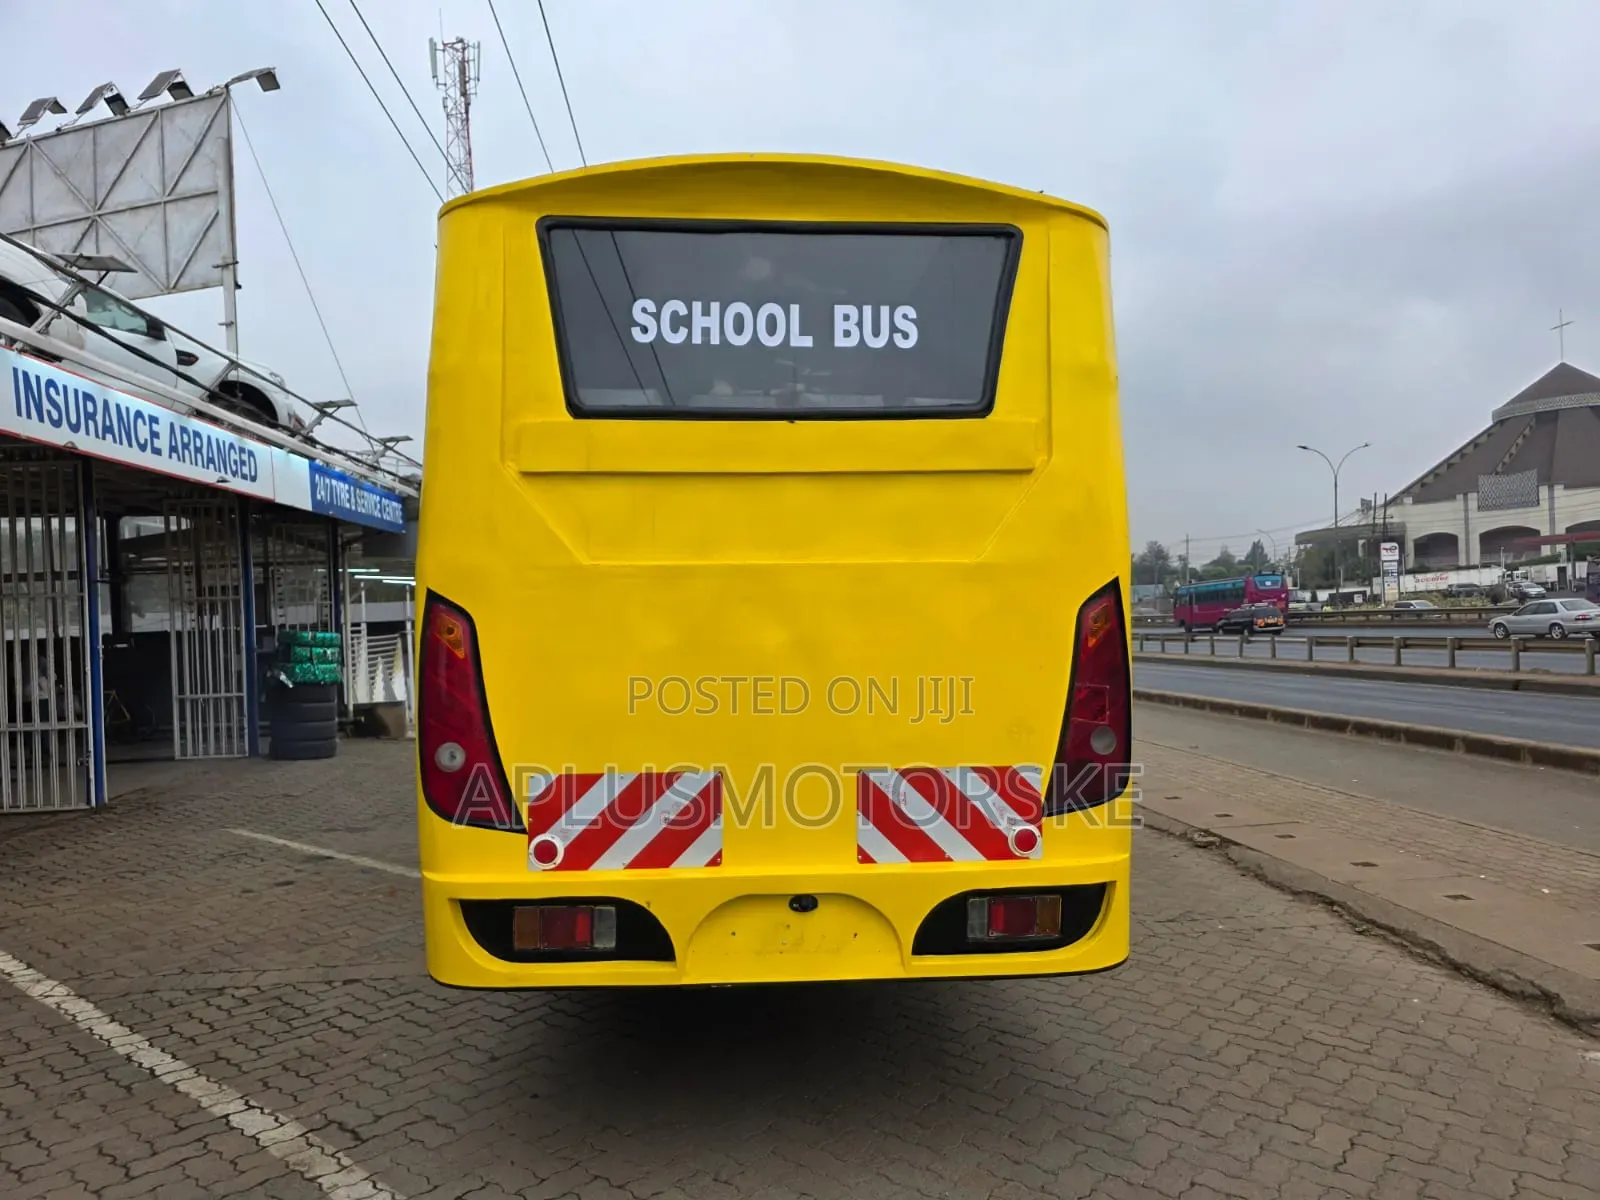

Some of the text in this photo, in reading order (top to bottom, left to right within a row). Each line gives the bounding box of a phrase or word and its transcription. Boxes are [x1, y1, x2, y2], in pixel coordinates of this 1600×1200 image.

[630, 298, 919, 349] SCHOOL BUS
[12, 367, 259, 483] INSURANCE ARRANGED
[314, 473, 330, 504] 24/7
[331, 478, 350, 509] TYRE
[356, 487, 381, 519] SERVICE
[381, 496, 403, 525] CENTRE
